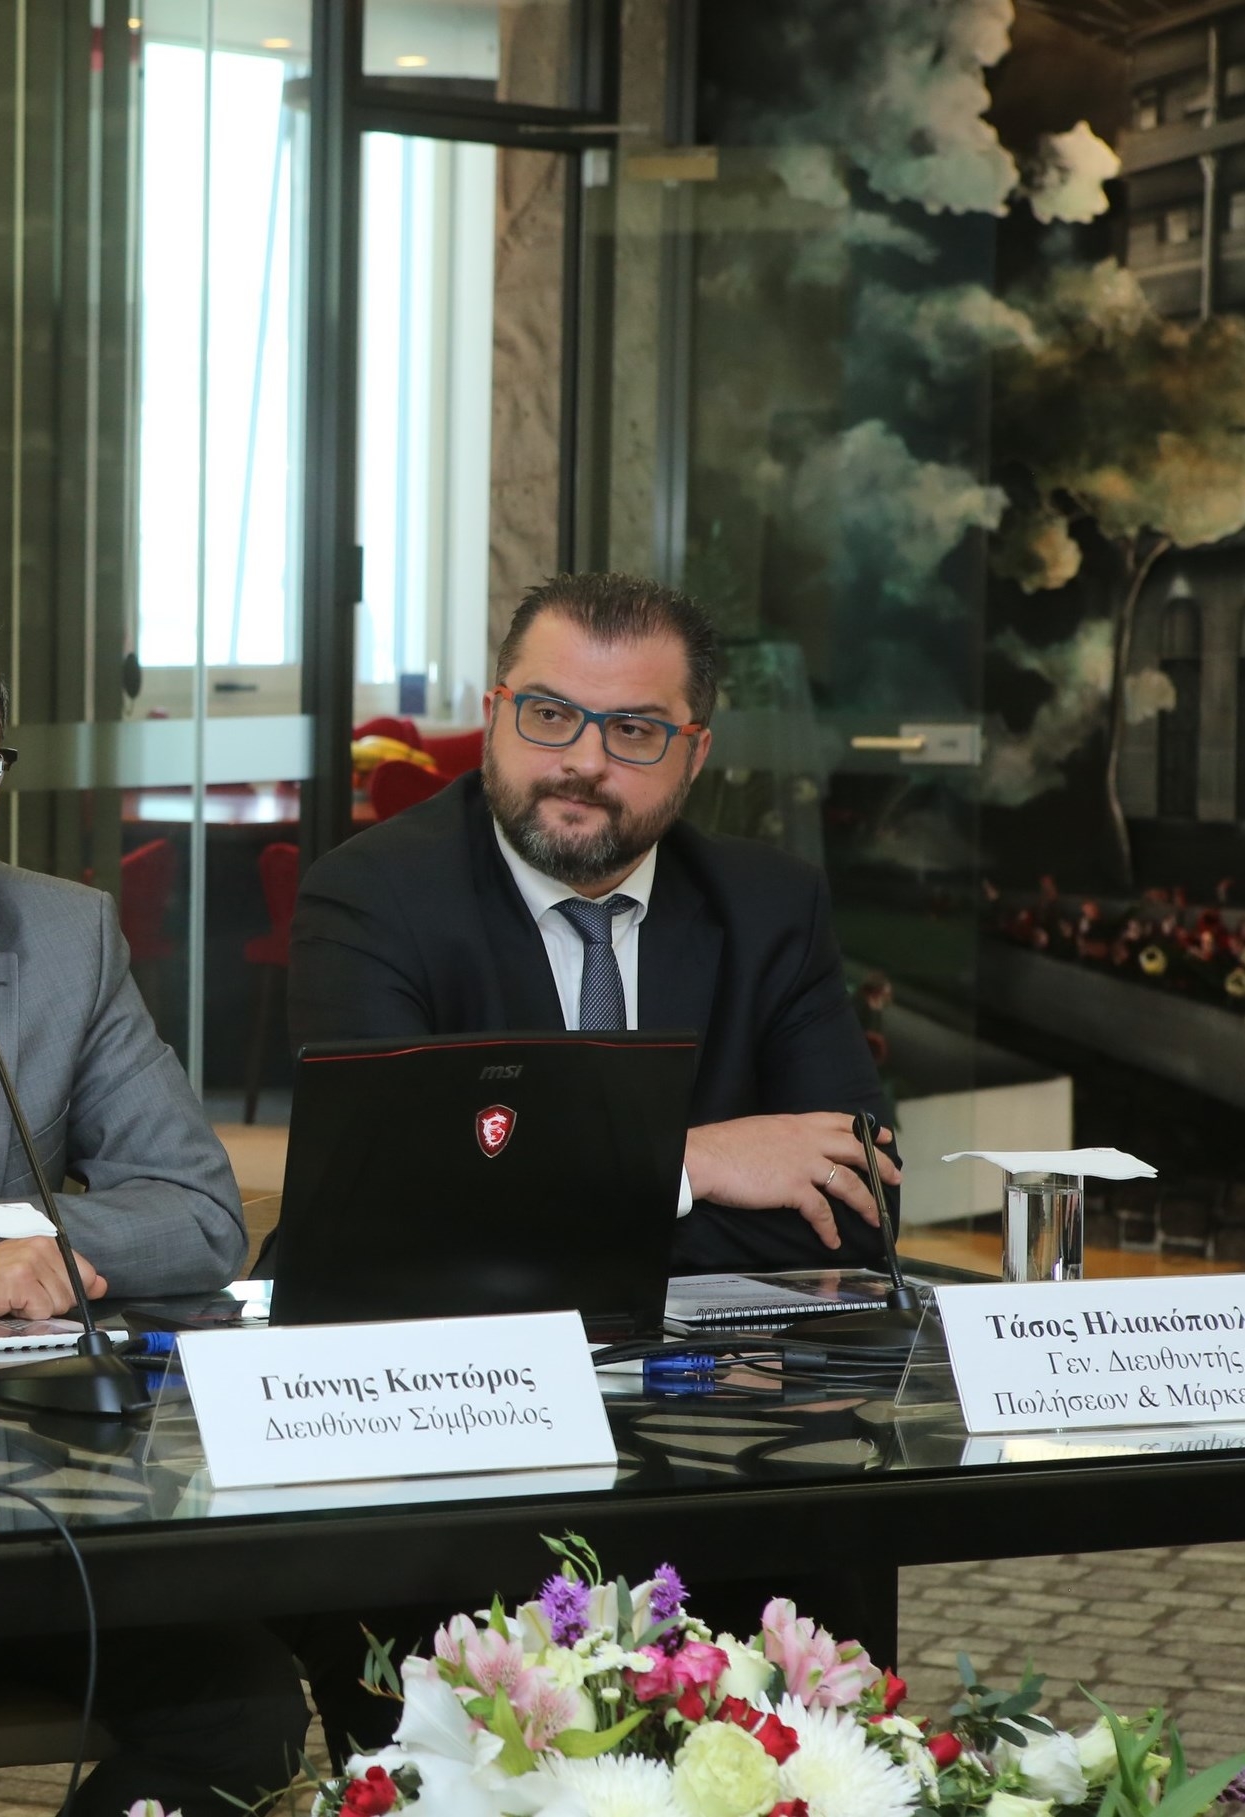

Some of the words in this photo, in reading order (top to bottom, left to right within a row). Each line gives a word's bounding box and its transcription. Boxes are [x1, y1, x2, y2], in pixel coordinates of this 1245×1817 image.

[479, 1064, 524, 1080] msi
[985, 1314, 1078, 1343] Τάσος
[1046, 1352, 1099, 1374] Γεν.
[1109, 1345, 1243, 1374] Διευθυντής
[260, 1374, 379, 1403] Γιάννης
[384, 1364, 536, 1394] Καντώρος
[993, 1389, 1128, 1418] Πωλήσεων
[1138, 1385, 1160, 1408] &
[266, 1411, 401, 1442] Διευθύνων
[409, 1402, 553, 1435] Σύμβουλος
